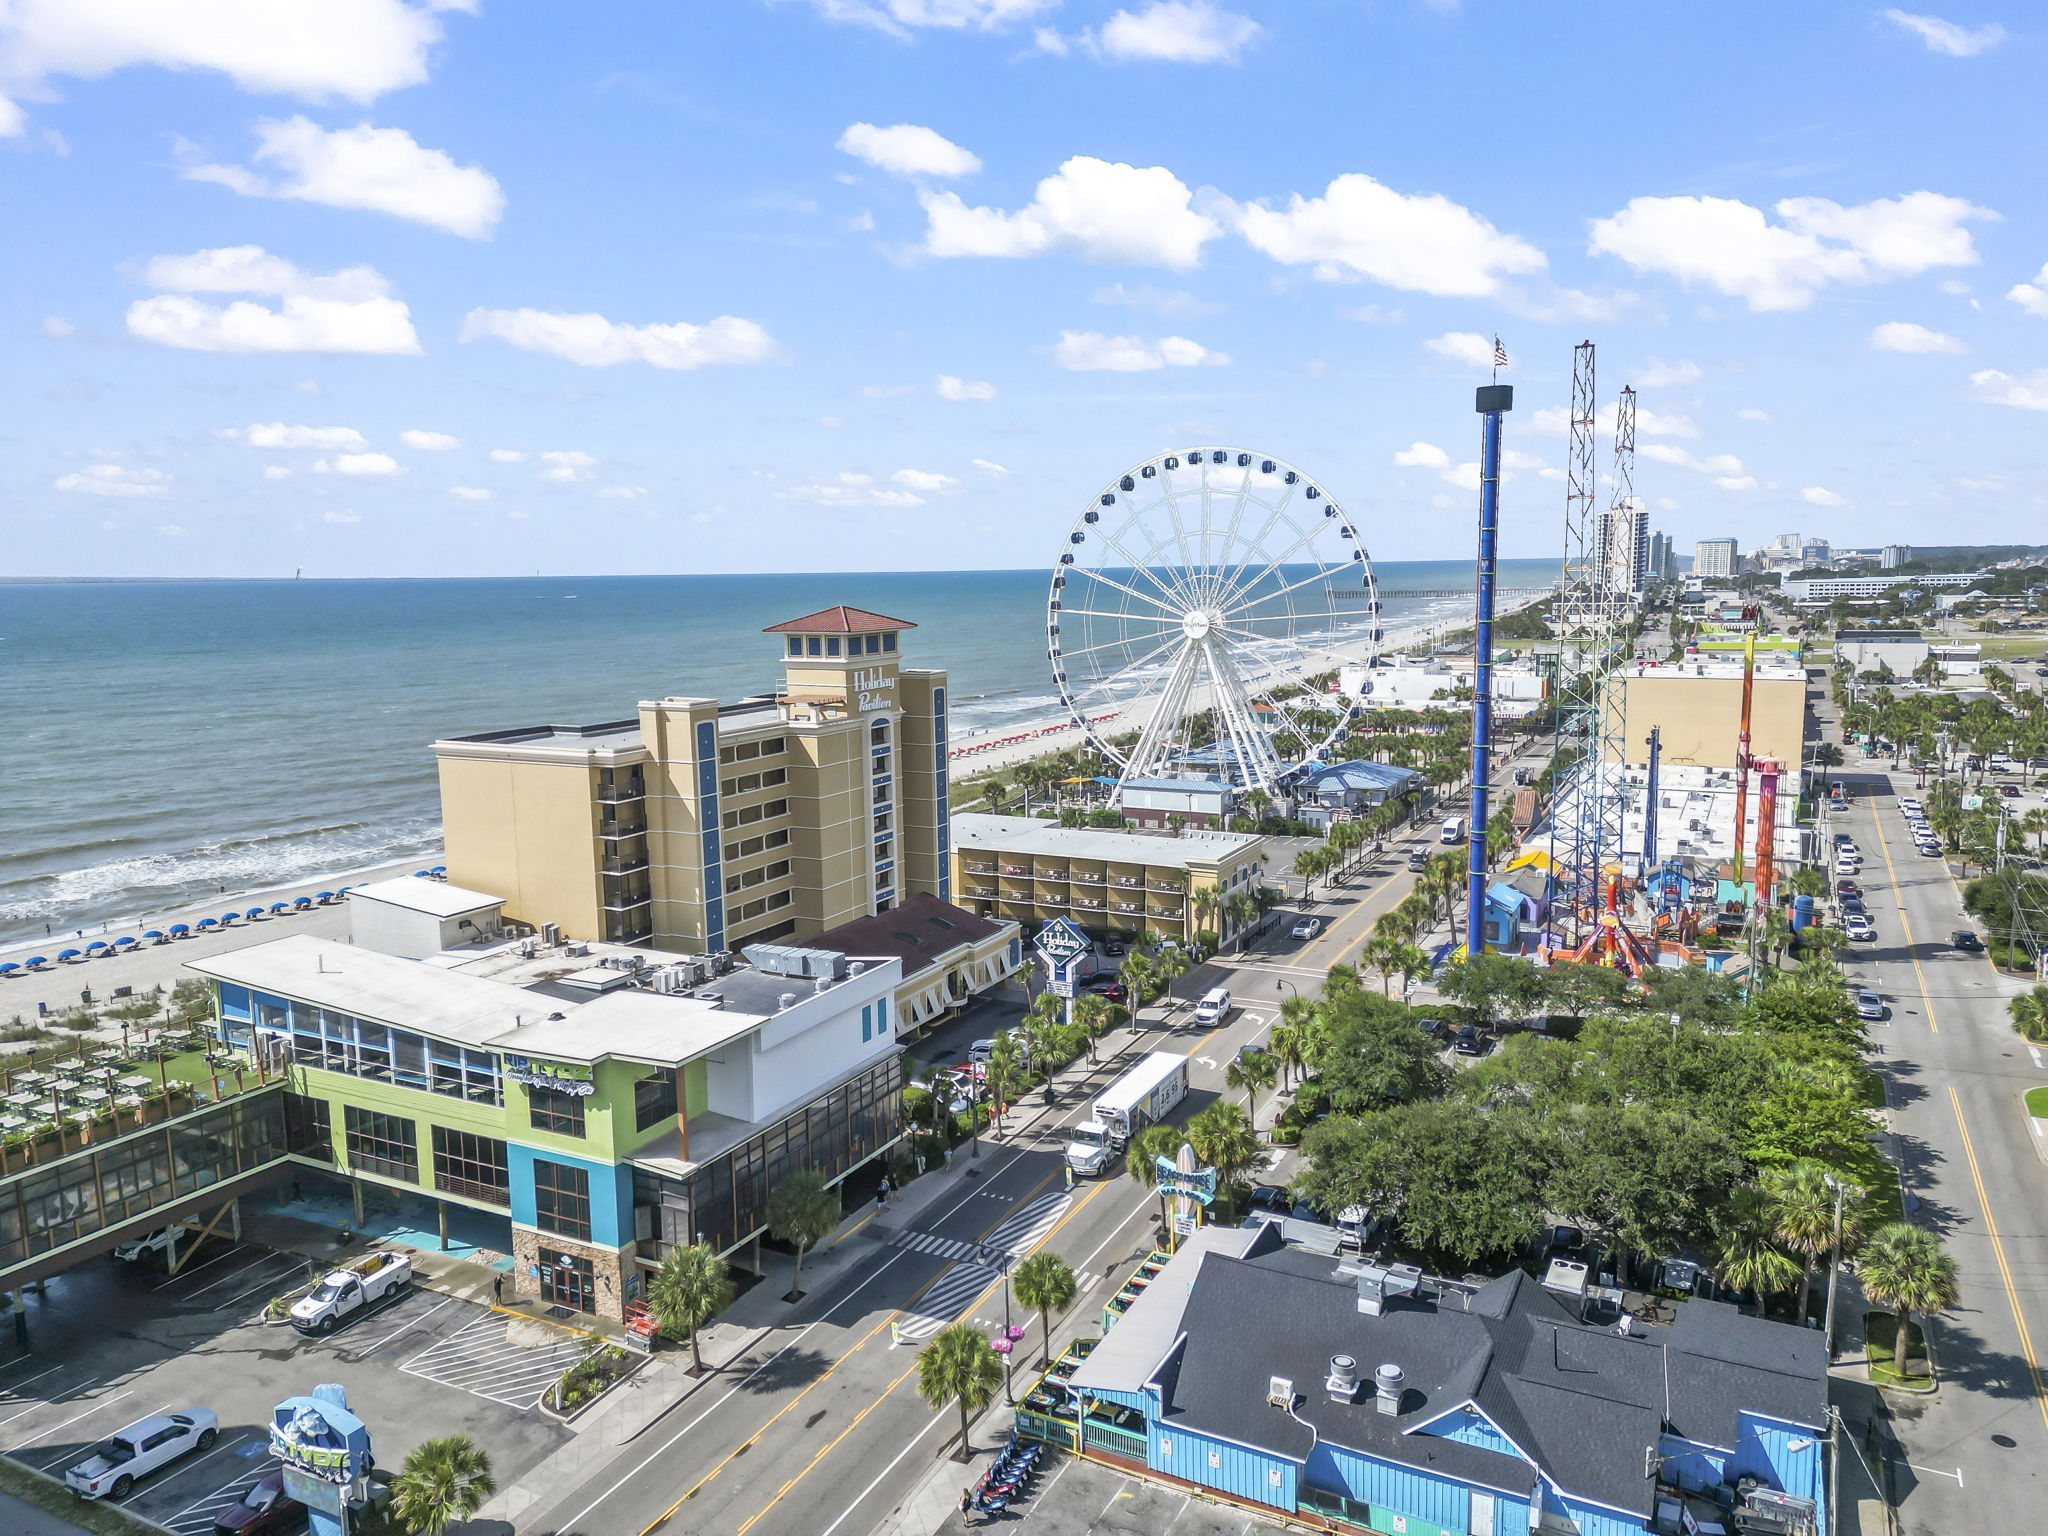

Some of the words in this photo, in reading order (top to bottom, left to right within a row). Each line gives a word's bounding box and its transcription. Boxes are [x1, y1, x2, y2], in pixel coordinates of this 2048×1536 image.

[853, 667, 895, 692] Holiday
[858, 692, 892, 712] Pavilion
[1043, 932, 1080, 949] Holiday
